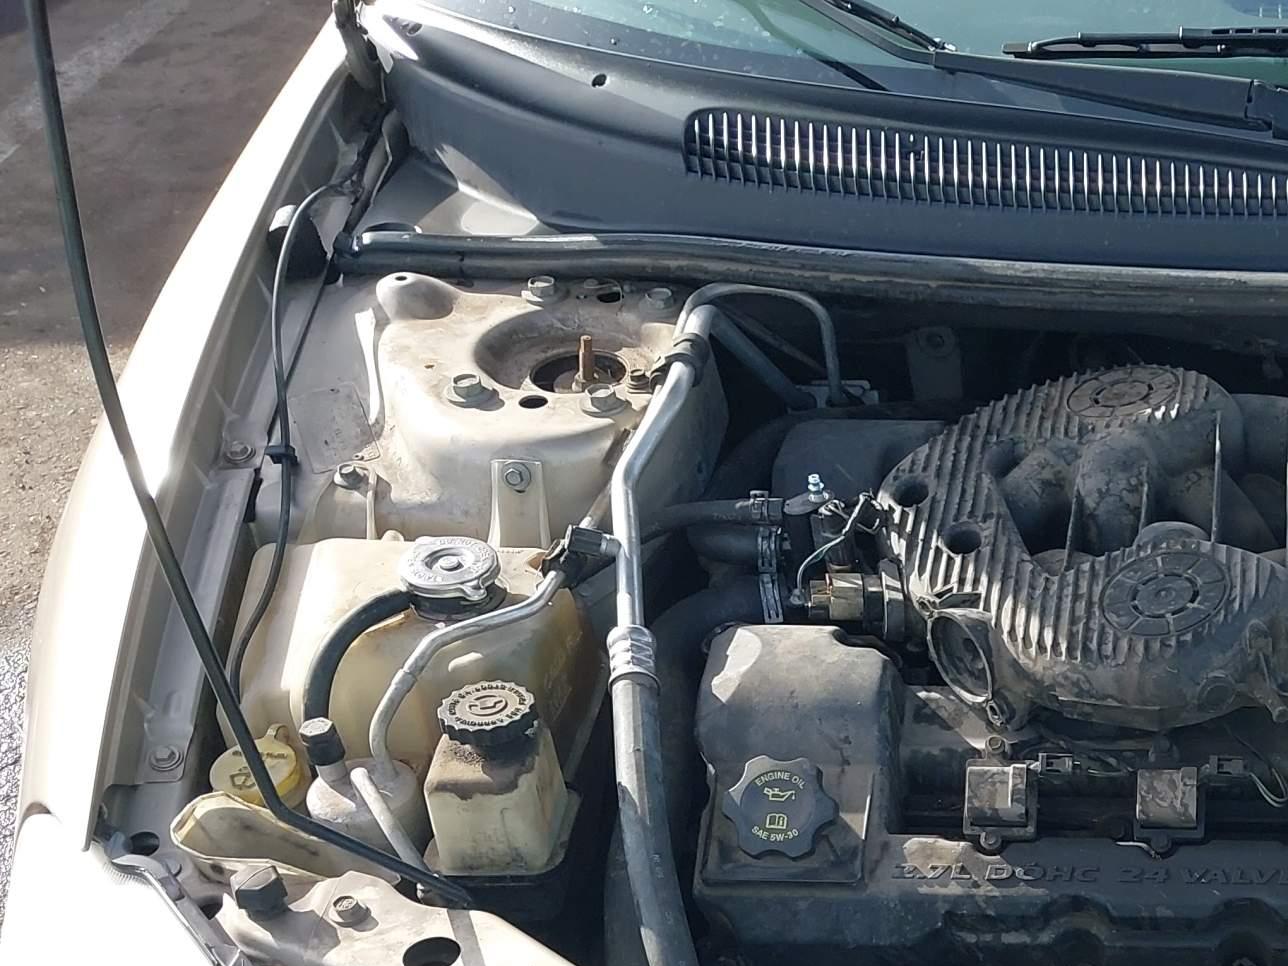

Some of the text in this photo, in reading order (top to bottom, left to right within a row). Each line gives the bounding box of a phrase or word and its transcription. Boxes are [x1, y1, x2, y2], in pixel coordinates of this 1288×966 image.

[754, 771, 806, 790] ENGINE OIL
[752, 826, 799, 842] SAE 5W-30
[892, 863, 972, 880] 2.7L
[985, 864, 1100, 882] DOHC
[1116, 866, 1169, 884] 24
